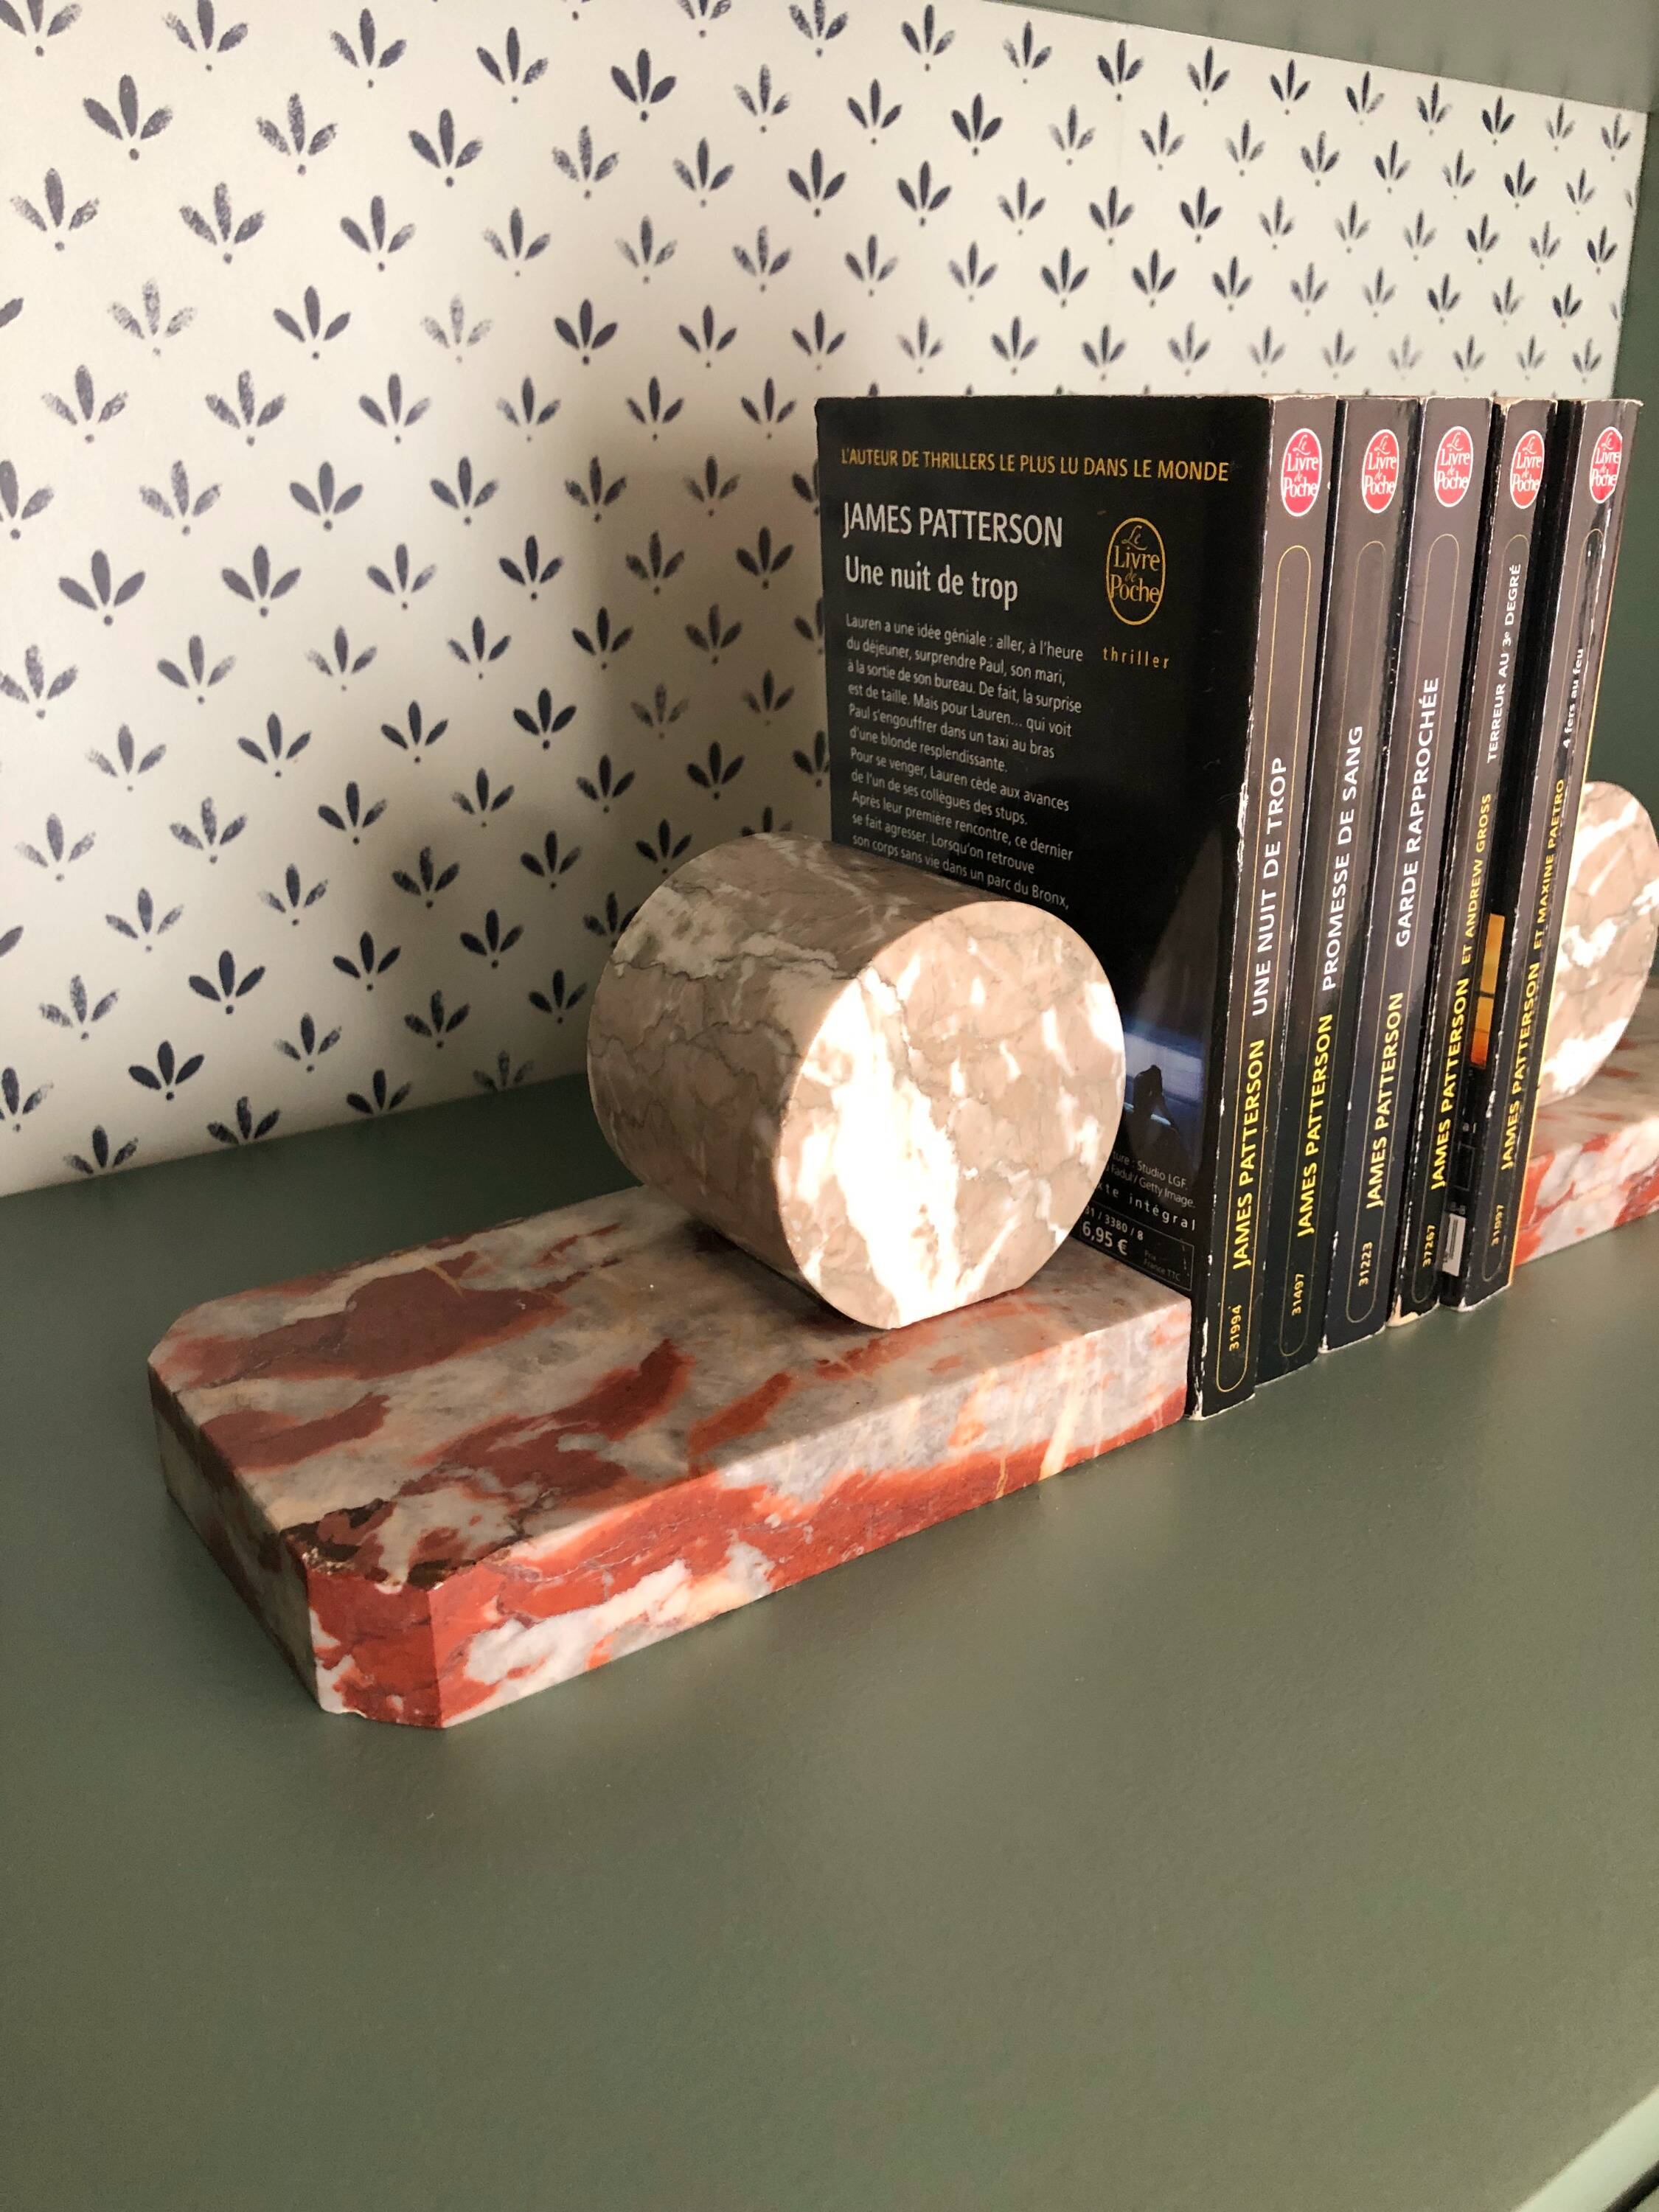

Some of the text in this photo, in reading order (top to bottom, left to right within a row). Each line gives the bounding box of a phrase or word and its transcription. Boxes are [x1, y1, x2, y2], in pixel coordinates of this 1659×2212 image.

[1293, 434, 1311, 455] Le
[1374, 435, 1391, 454] Le
[1441, 448, 1470, 466] Livre
[1447, 431, 1463, 451] Le
[1523, 436, 1537, 455] Le
[1595, 448, 1621, 465] Livre
[1601, 431, 1615, 451] Le
[841, 448, 1228, 481] L'AUTEUR DE THRILLERS LE PLUS LU DANS LE MONDE
[1287, 453, 1318, 471] Livre
[1368, 452, 1397, 470] Livre
[1516, 452, 1543, 470] Livre
[1284, 477, 1320, 497] Poche
[1365, 476, 1395, 495] Poche
[1437, 471, 1467, 490] Poche
[1513, 474, 1540, 493] Poche
[1592, 468, 1617, 487] Poche
[843, 501, 1062, 548] JAMES PATTERSON
[1121, 525, 1147, 550] Le
[1113, 545, 1161, 571] Livre
[845, 555, 1018, 611] Une nuit de trop
[1110, 574, 1160, 604] Poche
[846, 613, 1083, 661] Lauren a une idée géniale aller, l'heure
[847, 636, 1065, 686] du déjeuner, surprendre Paul, son mari,
[1103, 646, 1169, 669] thriller
[857, 661, 1082, 714] la sortie de son bureau. De fait, la surprise
[849, 683, 863, 696] est
[866, 686, 878, 699] de
[881, 689, 910, 705] taille.
[914, 693, 939, 710] Mais
[941, 701, 967, 716] pour
[1026, 716, 1045, 732] qui
[1048, 720, 1072, 737] voit
[849, 703, 1055, 759] Paul s'engouffrer dans un taxi au bras
[849, 726, 1007, 773] d'une blonde resplendissante.
[851, 748, 1069, 811] Pour se venger, Lauren cède aux avances
[852, 769, 1027, 826] de l'un de ses collègues des stups.
[852, 790, 1073, 861] Après leur première rencontre, ce dernier
[852, 814, 1034, 873] se fait agresser. Lorsqu'on retrouve
[853, 835, 1069, 909] son corps sans vie dans un parc du Bronx,
[1431, 563, 1521, 1191] JAMES PATTERSON ET ANDREW GROSS TERREUR AU DEGRÉ
[1500, 648, 1584, 1171] JAMES PATTERSON ET MAXINE PAETRO 4 fers au feu
[1366, 677, 1439, 1210] JAMES PATTERSON GARDE RAPPROCHÉE
[1297, 726, 1363, 1237] JAMES PATTERSON PROMESSE DE SANG
[1232, 757, 1287, 1270] JAMES PATTERSON UNE NUIT DE TROP
[1137, 1160, 1188, 1191] Studio LGF.
[1139, 1178, 1162, 1198] Getty
[1105, 1214, 1128, 1234] 3380
[1129, 1193, 1195, 1231] intégral
[1082, 1221, 1113, 1248] 6,95
[1358, 1242, 1373, 1287] 31223
[1291, 1273, 1304, 1316] 31497
[1229, 1304, 1242, 1352] 31994
